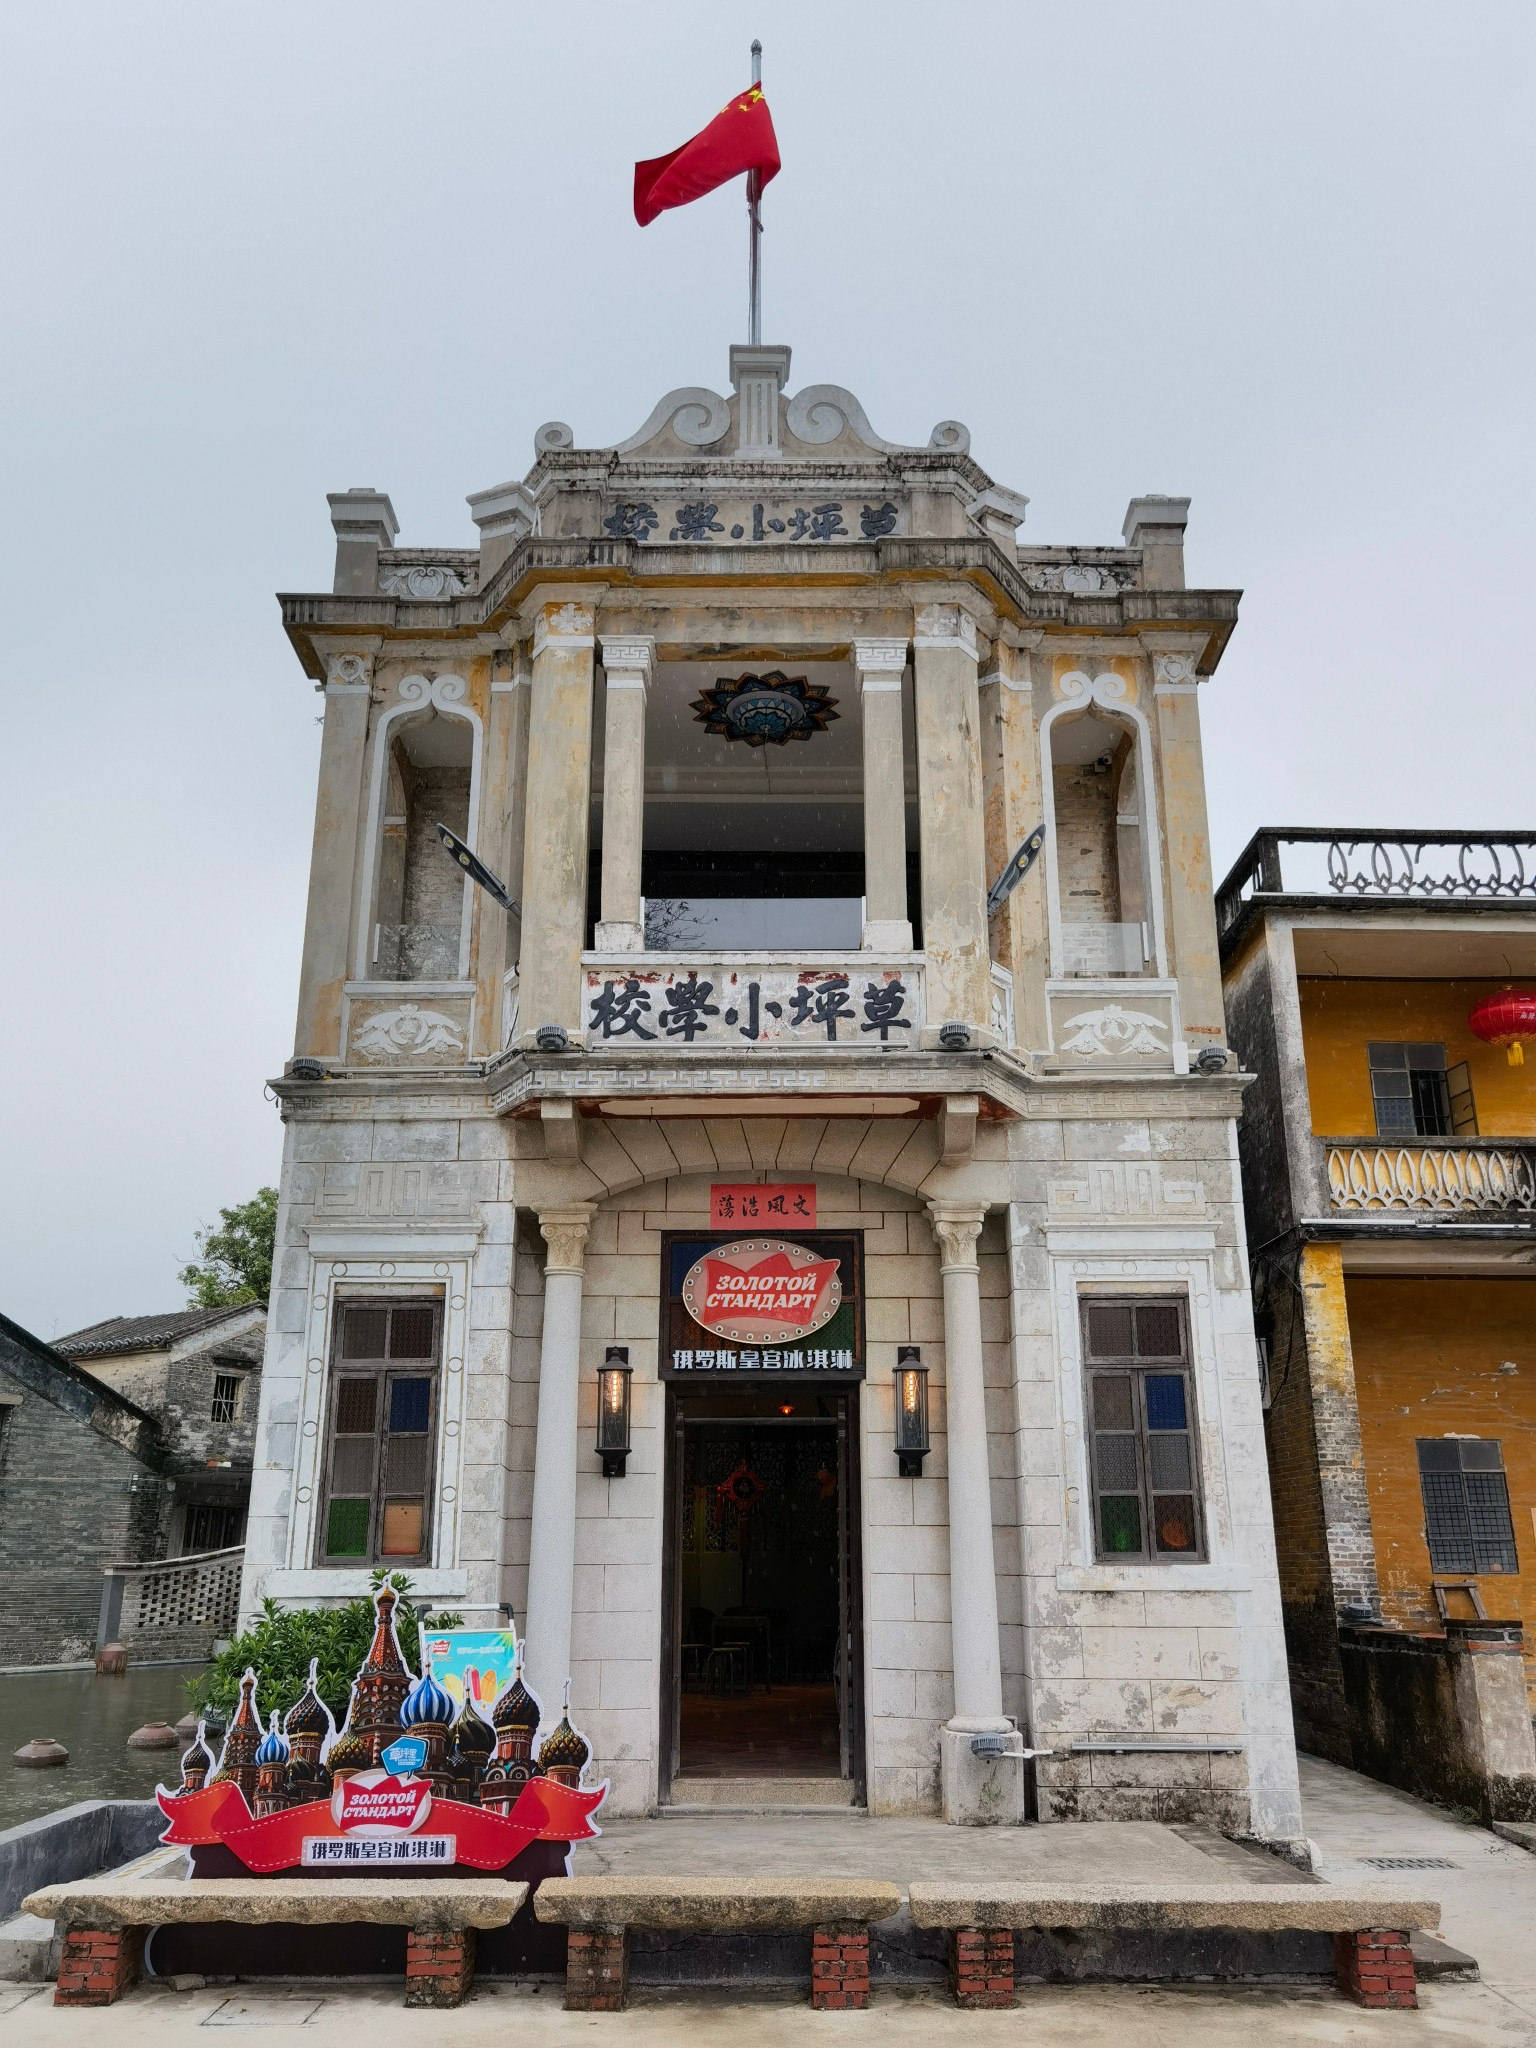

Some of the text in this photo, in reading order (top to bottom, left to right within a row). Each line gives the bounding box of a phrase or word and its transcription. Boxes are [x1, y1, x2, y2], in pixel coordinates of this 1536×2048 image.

[716, 1273, 817, 1291] ЗОЛОТОЙ
[707, 1294, 817, 1311] СТАНДАРТ
[673, 1349, 852, 1369] 俄罗斯皇宫冰淇淋
[350, 1790, 417, 1805] ЗОЛОТОЙ
[343, 1806, 416, 1818] СТАНДАРТ
[312, 1841, 447, 1859] 俄罗斯皇宫冰淇淋
